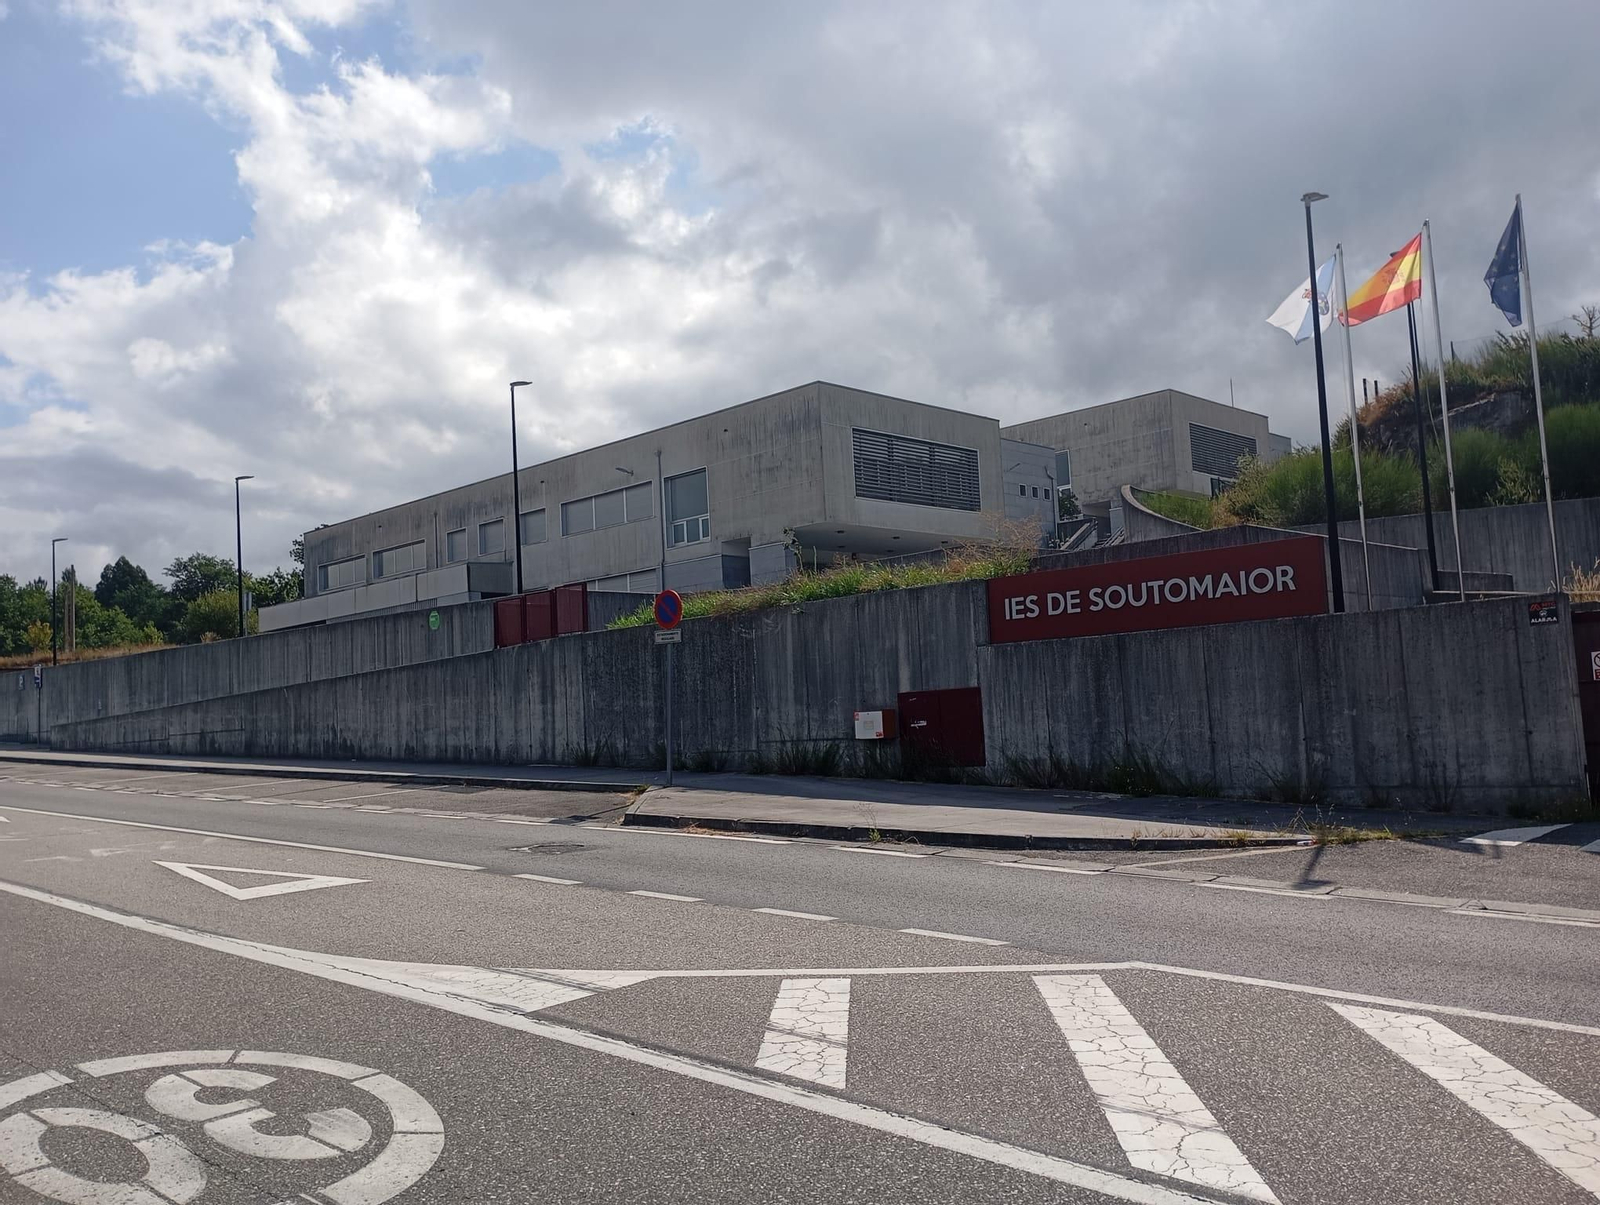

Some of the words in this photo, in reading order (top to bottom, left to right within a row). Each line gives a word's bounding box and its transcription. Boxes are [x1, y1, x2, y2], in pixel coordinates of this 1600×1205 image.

[1004, 595, 1040, 620] IES
[1047, 590, 1081, 616] DE
[1089, 565, 1297, 612] SOUTOMAIOR
